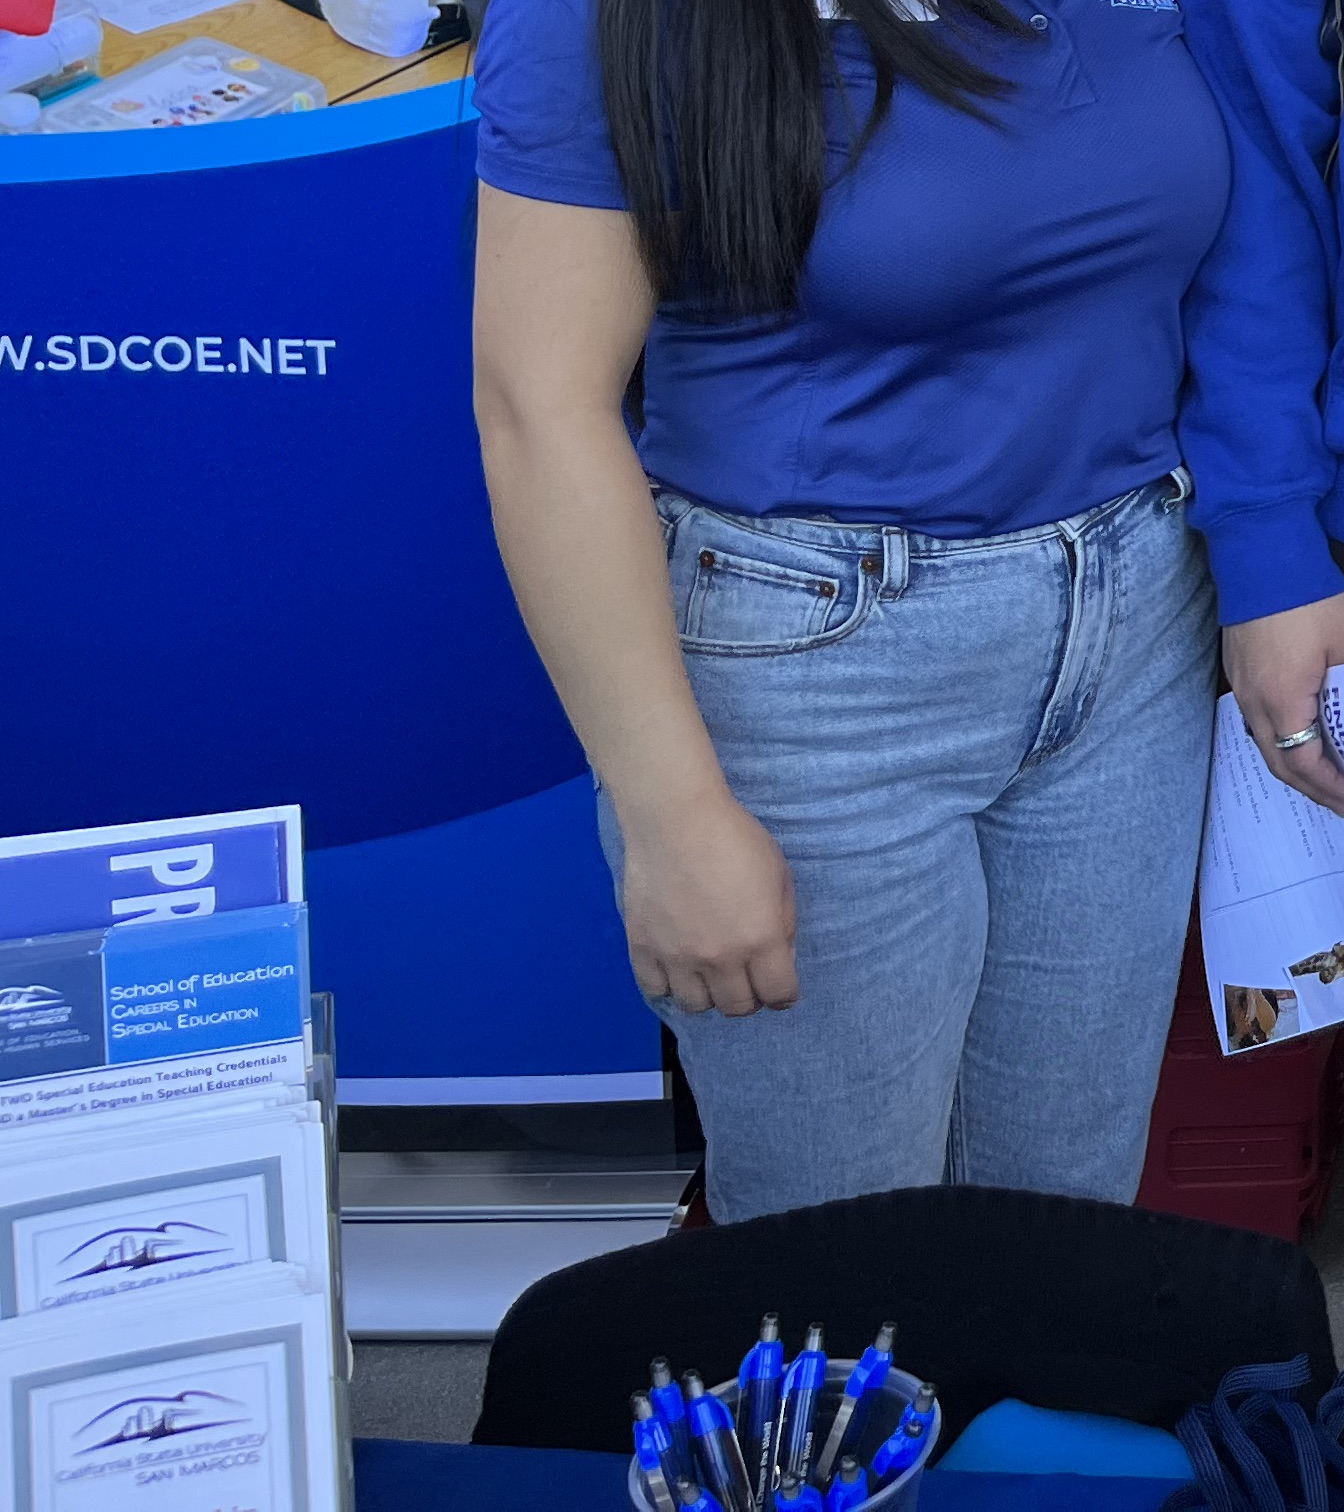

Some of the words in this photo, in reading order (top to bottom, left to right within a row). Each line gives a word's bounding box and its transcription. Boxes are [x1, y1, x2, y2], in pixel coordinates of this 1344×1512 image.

[110, 979, 174, 1002] School
[178, 974, 200, 994] of
[203, 963, 294, 988] Education
[177, 1006, 259, 1029] EDUCATION
[89, 1075, 152, 1092] Education
[155, 1065, 213, 1083] Teaching
[216, 1053, 287, 1073] Credentials
[90, 1093, 137, 1110] Degree
[157, 1083, 203, 1101] Special
